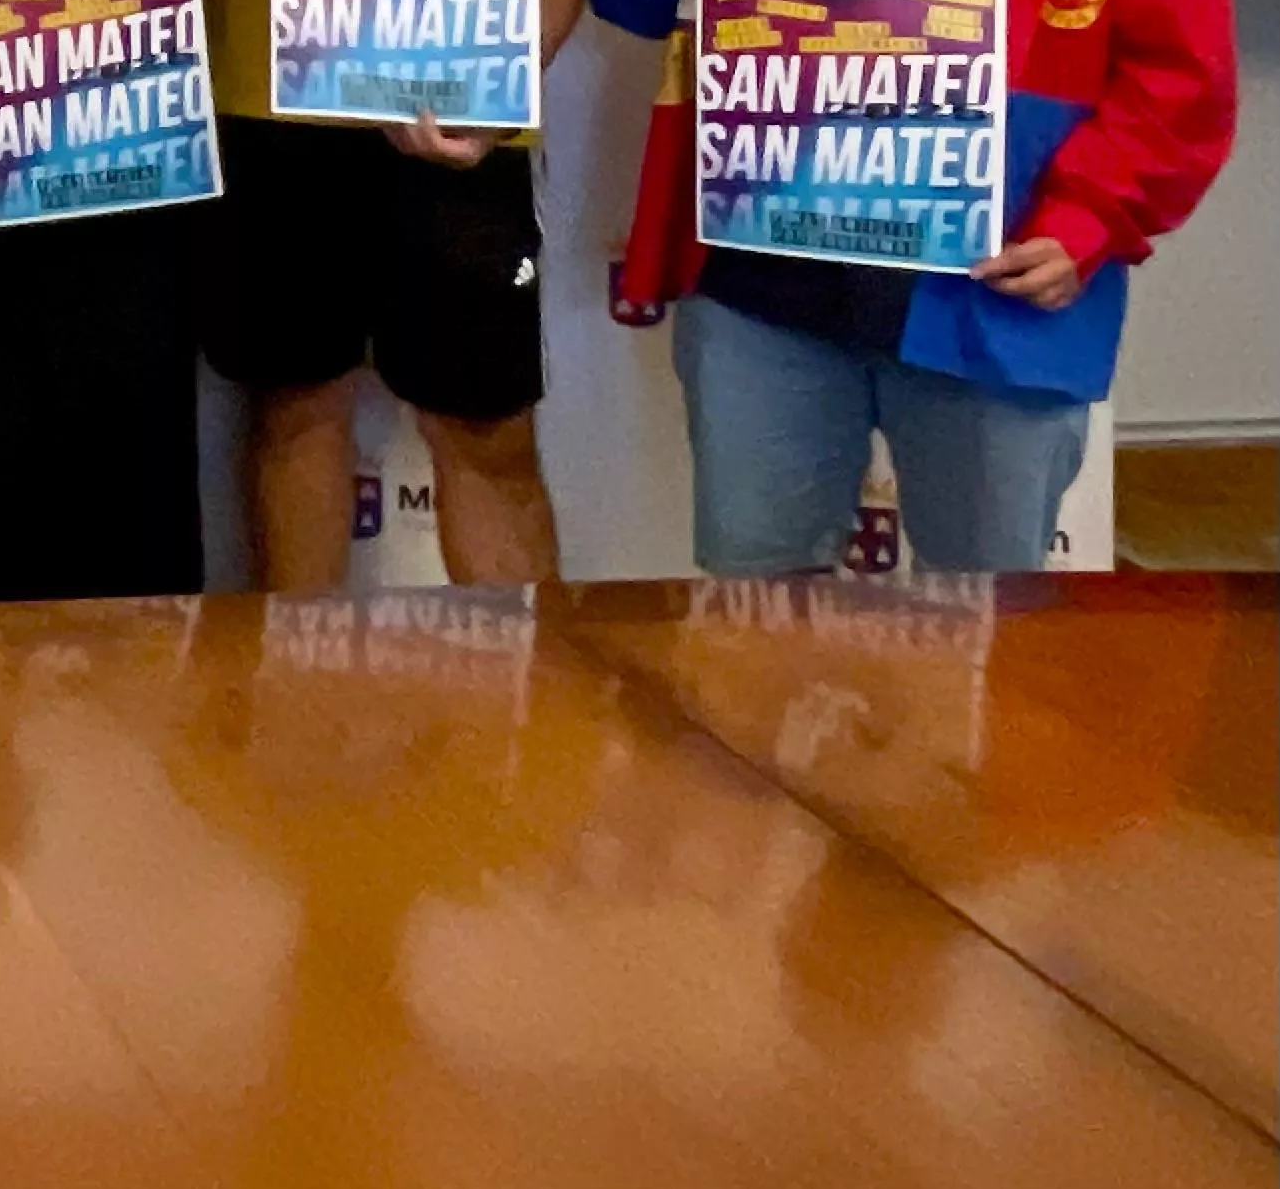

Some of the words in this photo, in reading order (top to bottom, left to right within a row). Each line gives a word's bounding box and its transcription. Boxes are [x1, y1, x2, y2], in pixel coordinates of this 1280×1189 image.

[58, 2, 200, 84] MATEO
[66, 67, 207, 148] MATEO
[698, 53, 801, 114] SAN
[815, 54, 998, 115] MATEO
[699, 122, 799, 182] SAN
[814, 127, 996, 187] MATEO
